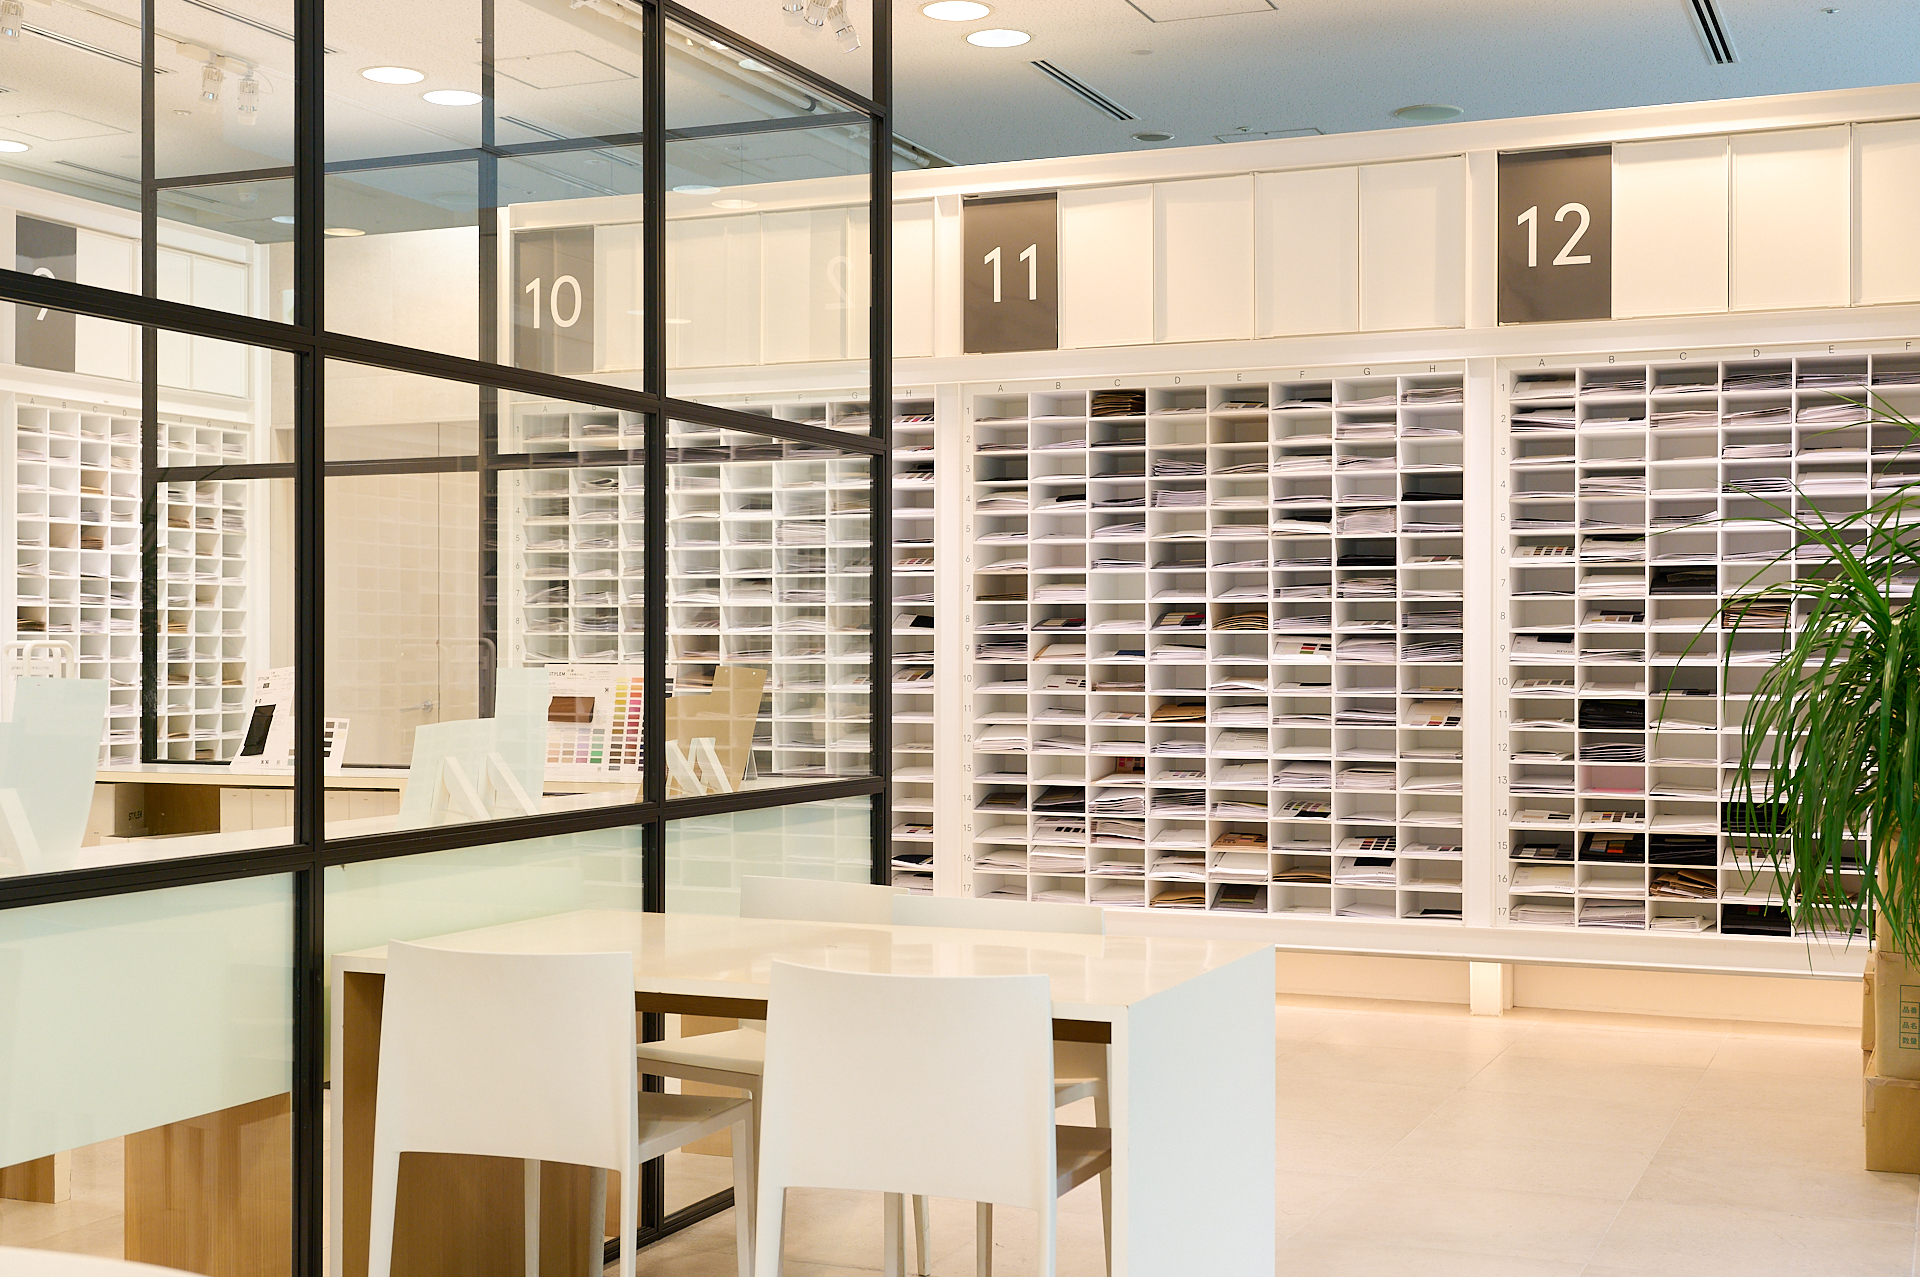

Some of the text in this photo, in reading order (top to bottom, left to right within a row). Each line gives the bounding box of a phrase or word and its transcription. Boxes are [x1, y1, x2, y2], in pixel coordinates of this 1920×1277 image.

[1518, 202, 1592, 268] 12
[984, 244, 1036, 303] 11
[526, 274, 582, 328] 10
[1538, 342, 1912, 366] A B C D E F
[998, 364, 1436, 392] A B C D E F G H
[1500, 414, 1506, 422] 2
[966, 434, 970, 444] 2
[1500, 448, 1506, 456] 3
[966, 464, 970, 472] 3
[1500, 480, 1506, 488] 4
[966, 494, 970, 502] 4
[1500, 512, 1506, 522] 5
[966, 524, 970, 532] 5
[1500, 546, 1506, 554] 6
[966, 554, 970, 562] 6
[1500, 578, 1506, 586] 7
[966, 584, 970, 592] 7
[966, 614, 970, 622] 8
[1500, 612, 1506, 620] 8
[1500, 644, 1506, 652] 9
[964, 674, 972, 682] 10
[1498, 676, 1508, 686] 10
[964, 704, 972, 712] 11
[1498, 710, 1508, 718] 11
[964, 734, 972, 742] 12
[1498, 742, 1508, 752] 12
[964, 764, 972, 772] 13
[1498, 776, 1508, 784] 13
[1498, 808, 1508, 816] 14
[964, 824, 972, 832] 15
[1498, 842, 1508, 850] 15
[964, 854, 972, 862] 16
[1498, 874, 1508, 882] 16
[962, 884, 972, 892] 17
[1498, 908, 1508, 916] 17
[1902, 1006, 1917, 1014] 品番
[1902, 1022, 1918, 1030] 品名
